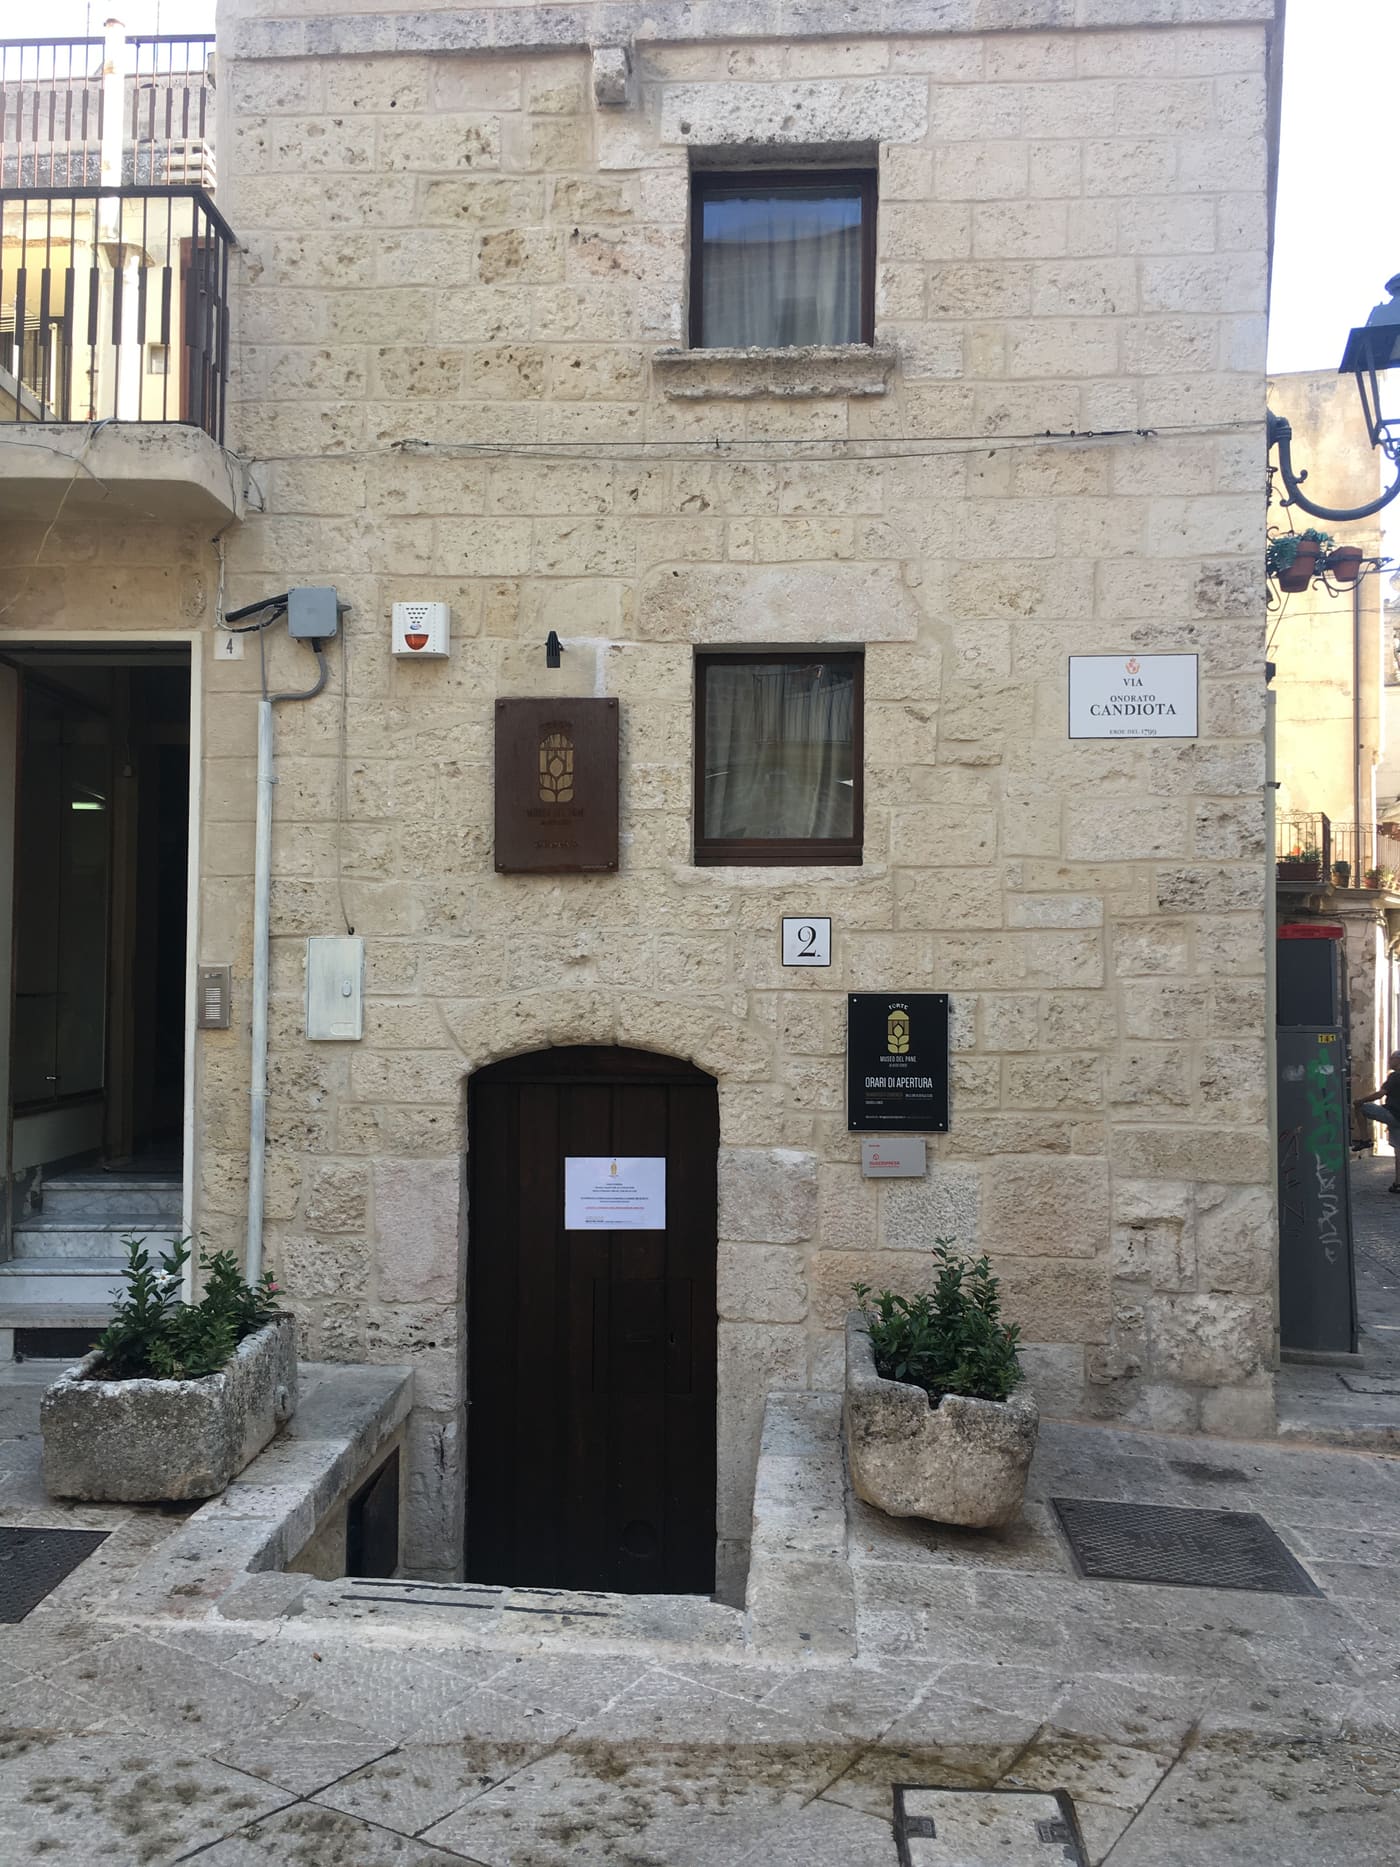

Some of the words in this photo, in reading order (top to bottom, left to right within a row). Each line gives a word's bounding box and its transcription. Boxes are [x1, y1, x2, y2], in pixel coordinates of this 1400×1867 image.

[226, 638, 233, 654] 4
[1123, 678, 1143, 687] VIA
[1110, 695, 1156, 703] ONORATO
[1090, 704, 1176, 716] CANDIOTA
[865, 1077, 886, 1088] ORARI
[888, 1077, 895, 1088] DI
[896, 1077, 933, 1088] APERTURA
